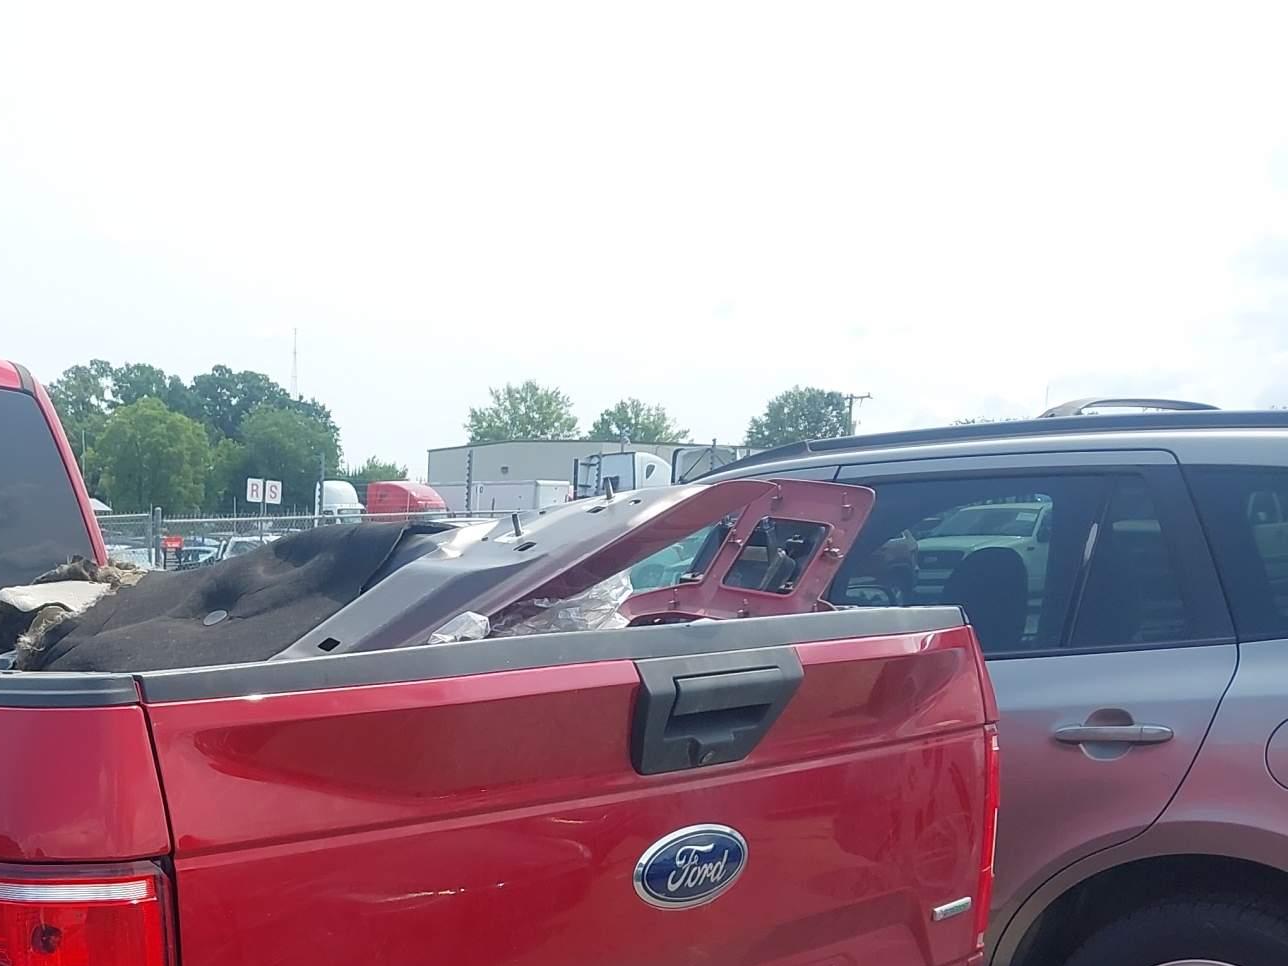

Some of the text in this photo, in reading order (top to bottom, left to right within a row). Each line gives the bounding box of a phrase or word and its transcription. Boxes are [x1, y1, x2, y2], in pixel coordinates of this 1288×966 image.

[251, 483, 278, 500] R S
[667, 843, 728, 891] Ford
